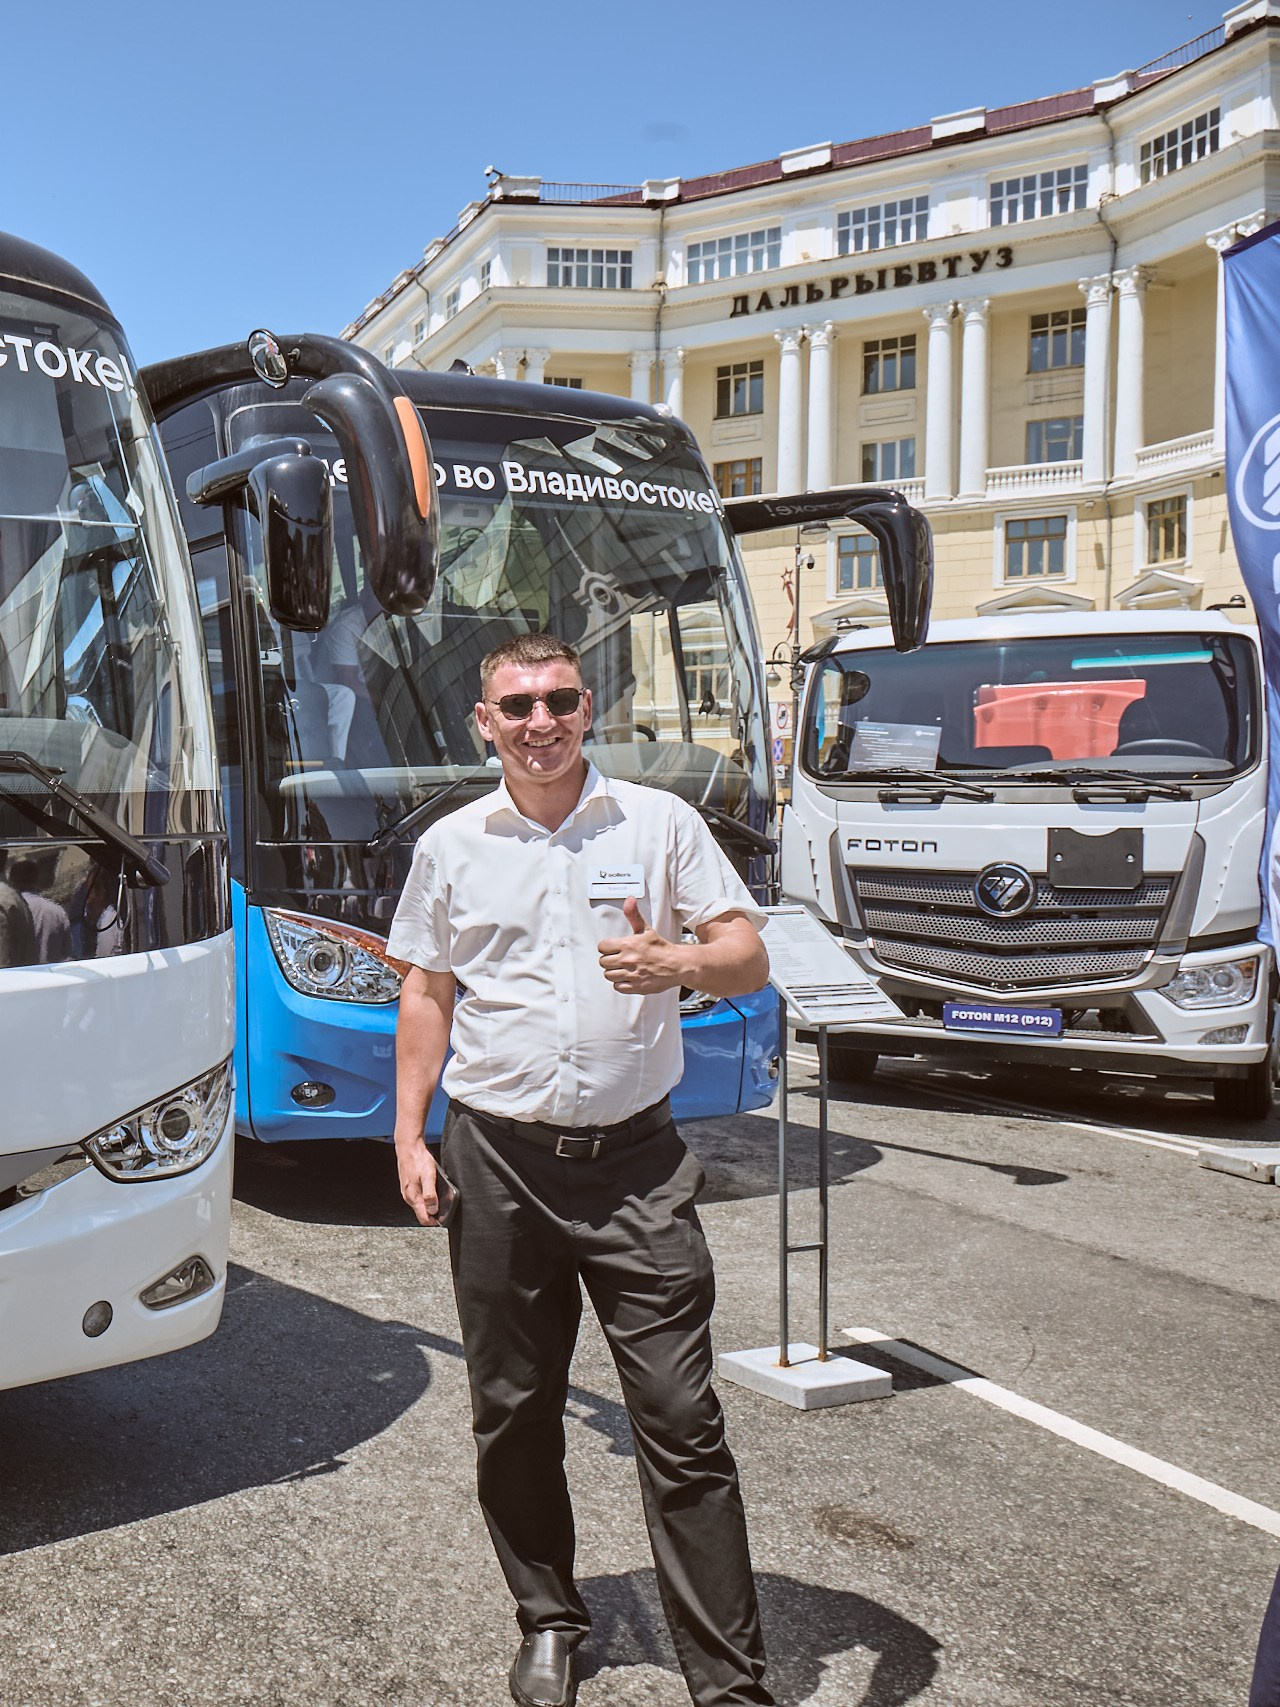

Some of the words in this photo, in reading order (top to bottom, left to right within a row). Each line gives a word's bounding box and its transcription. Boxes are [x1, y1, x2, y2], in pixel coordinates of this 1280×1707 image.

[729, 246, 1014, 319] ДАЛЬРЫБВТУЗ
[453, 464, 496, 491] во
[502, 461, 722, 516] Владивостоке!
[951, 1010, 992, 1022] FOTON
[993, 1013, 1019, 1024] M12
[1021, 1014, 1053, 1028] (D12)
